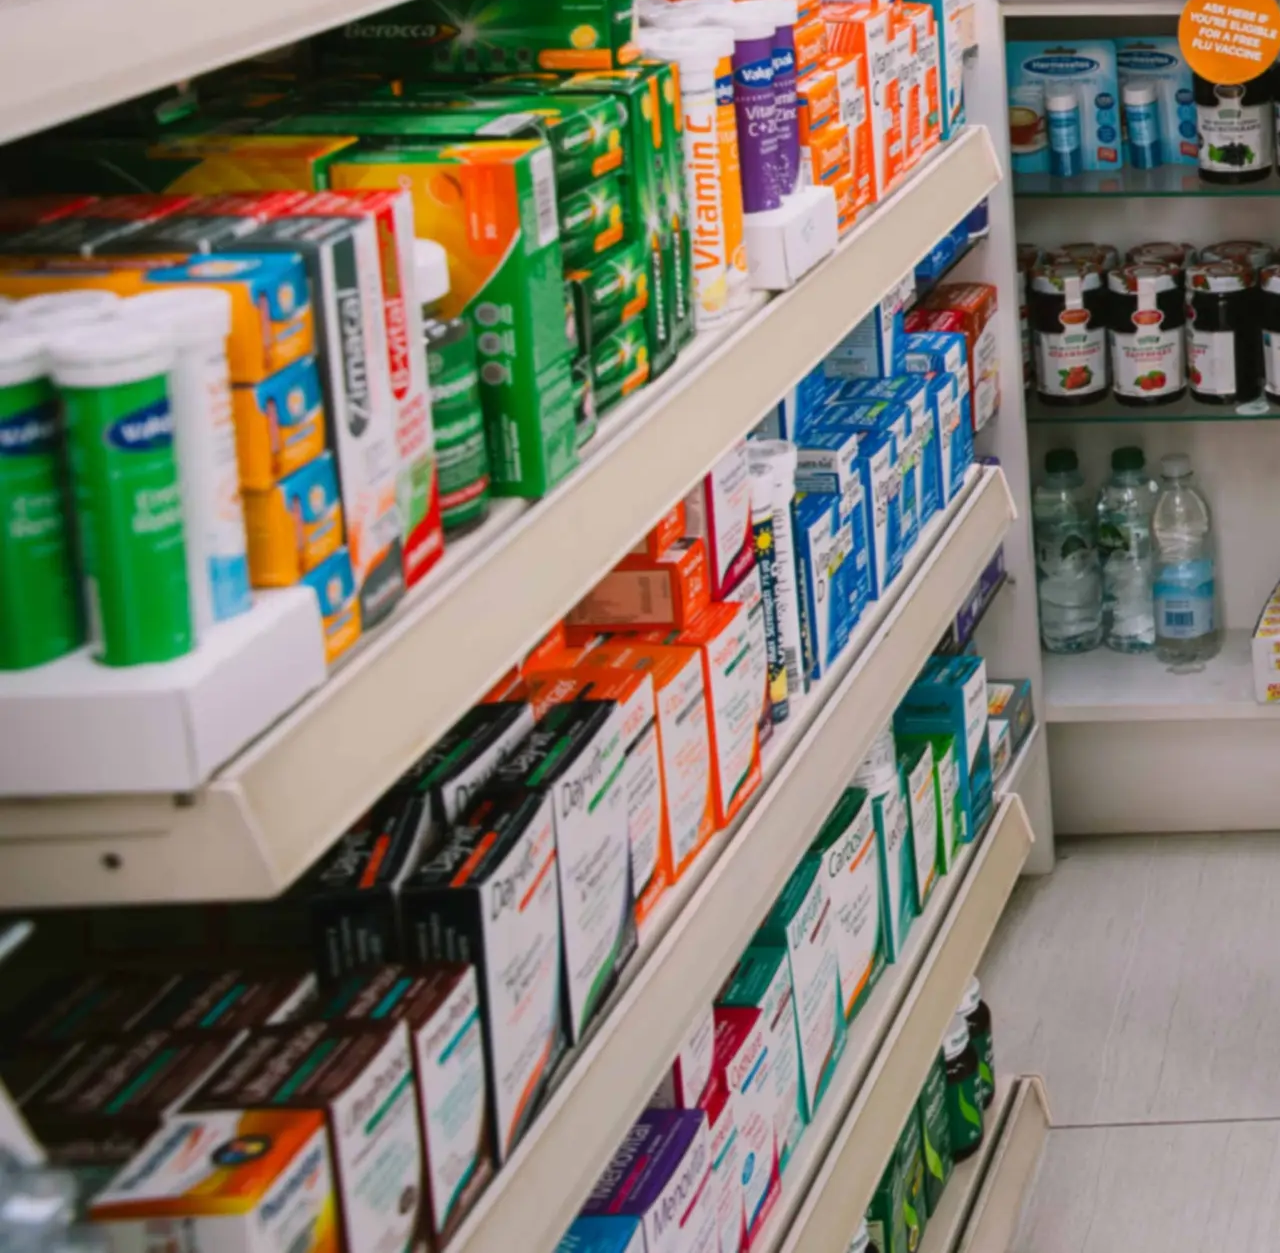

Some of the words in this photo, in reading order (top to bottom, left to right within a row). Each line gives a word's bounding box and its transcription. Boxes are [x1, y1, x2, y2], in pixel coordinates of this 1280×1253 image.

[1202, 2, 1226, 16] ASK
[1227, 7, 1256, 23] HERE
[1257, 11, 1269, 24] IF
[1190, 12, 1228, 30] YOU'RE
[1229, 20, 1278, 41] ELIGIBLE
[1198, 26, 1221, 41] FOR
[1233, 34, 1262, 49] FREE
[1191, 39, 1213, 52] FLU
[1214, 44, 1263, 63] VACCINE
[684, 113, 714, 138] C
[693, 153, 720, 271] Vitamin
